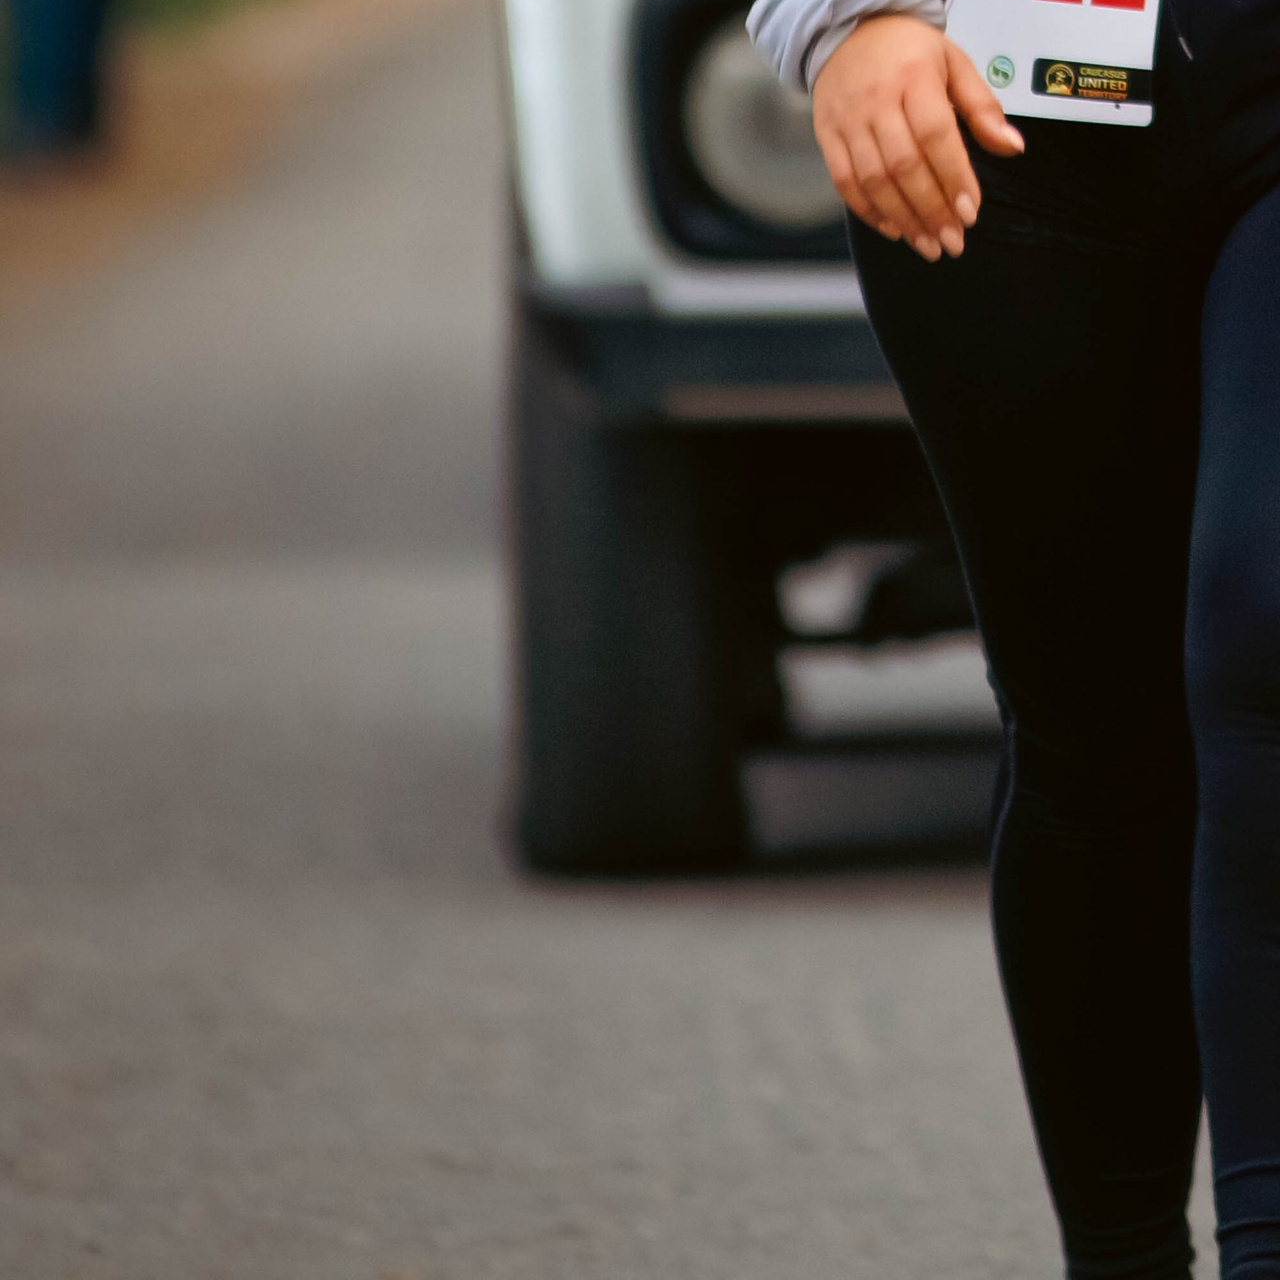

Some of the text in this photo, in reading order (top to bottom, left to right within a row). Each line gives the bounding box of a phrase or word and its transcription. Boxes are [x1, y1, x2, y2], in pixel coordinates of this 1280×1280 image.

[1079, 67, 1127, 80] CAUCASUS
[1078, 77, 1128, 91] UNITED
[1078, 88, 1128, 100] TERRITORY
